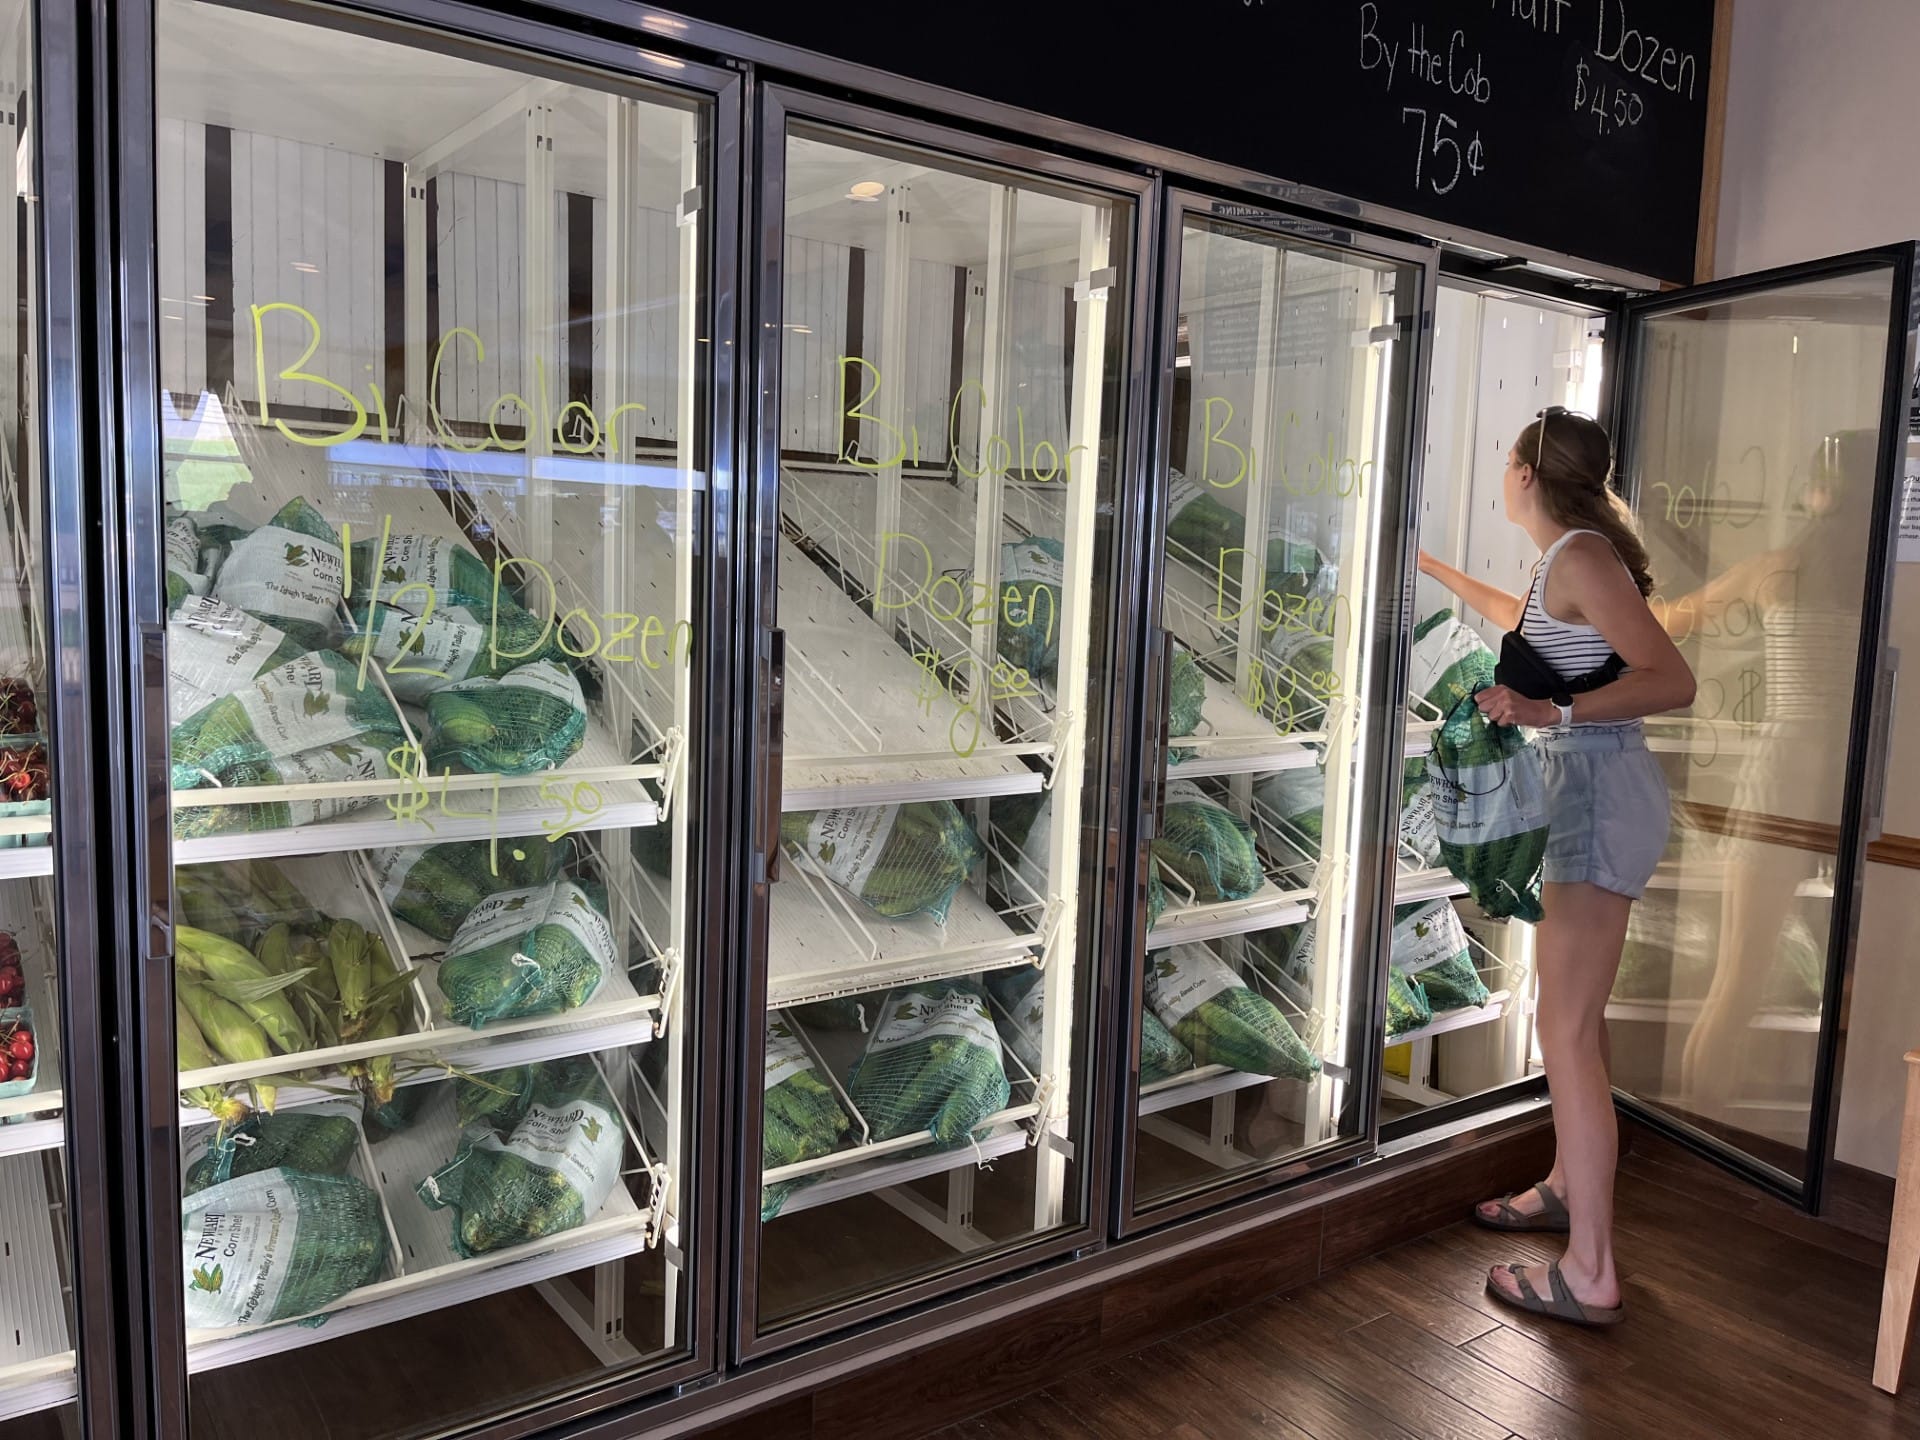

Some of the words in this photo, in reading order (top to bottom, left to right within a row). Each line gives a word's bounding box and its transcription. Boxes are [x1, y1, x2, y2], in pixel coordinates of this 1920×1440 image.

[1360, 2, 1399, 92] By
[1407, 22, 1443, 84] the
[1448, 30, 1491, 104] Cob
[1574, 56, 1644, 135] $4.50
[1593, 0, 1696, 100] Dozen
[1402, 107, 1485, 195] 75¢
[250, 302, 389, 447] Bi
[431, 327, 646, 453] Color
[837, 355, 919, 469] Bi
[950, 379, 1088, 482] Color
[1202, 397, 1257, 488] Bi
[1279, 405, 1375, 498] Color
[313, 568, 333, 583] Corn
[342, 515, 451, 692] 1/2
[489, 557, 694, 669] Dozen
[873, 533, 1055, 648] Dozen
[1218, 547, 1351, 649] Dozen
[838, 817, 853, 839] Corn
[224, 1232, 240, 1257] Corn
[238, 1309, 252, 1324] The
[247, 1283, 265, 1311] Lehigh
[258, 1253, 275, 1283] Valley's
